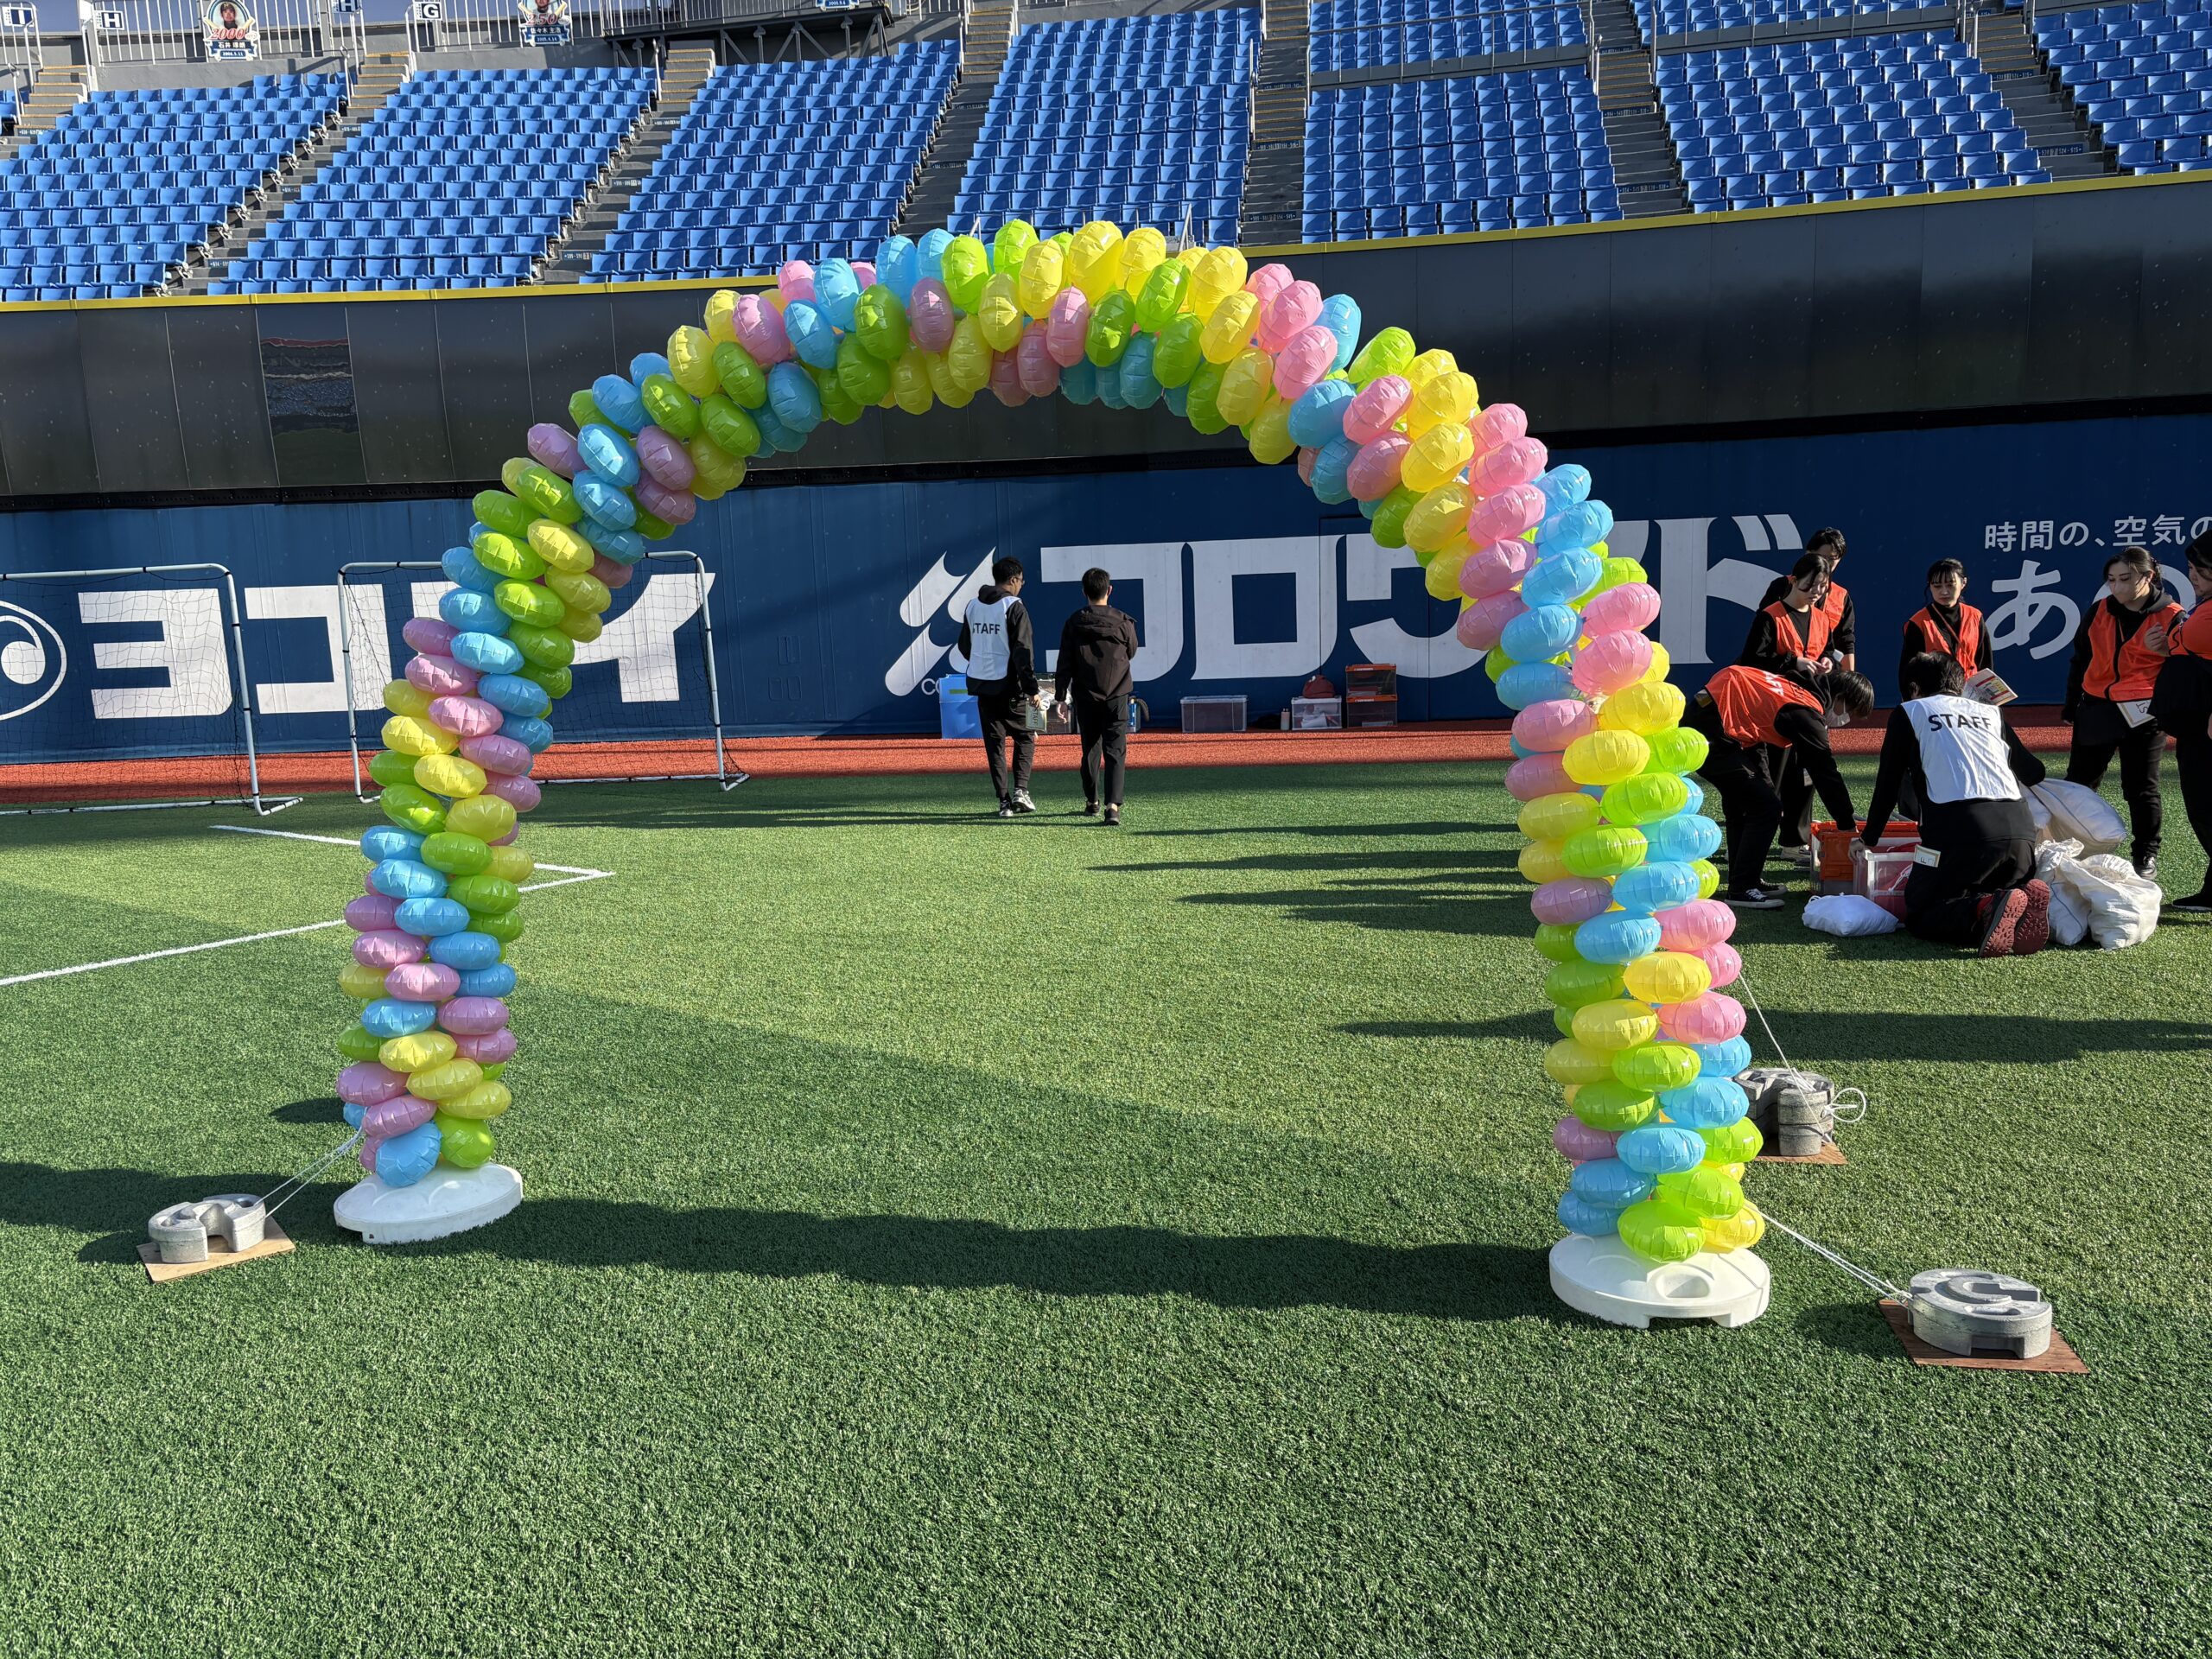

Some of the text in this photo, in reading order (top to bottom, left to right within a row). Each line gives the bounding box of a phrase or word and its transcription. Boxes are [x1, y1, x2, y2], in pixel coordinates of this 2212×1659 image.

[423, 3, 441, 18] G
[104, 12, 121, 28] H
[526, 13, 557, 25] 250
[209, 28, 245, 40] 2000
[1928, 714, 1992, 732] STAFF
